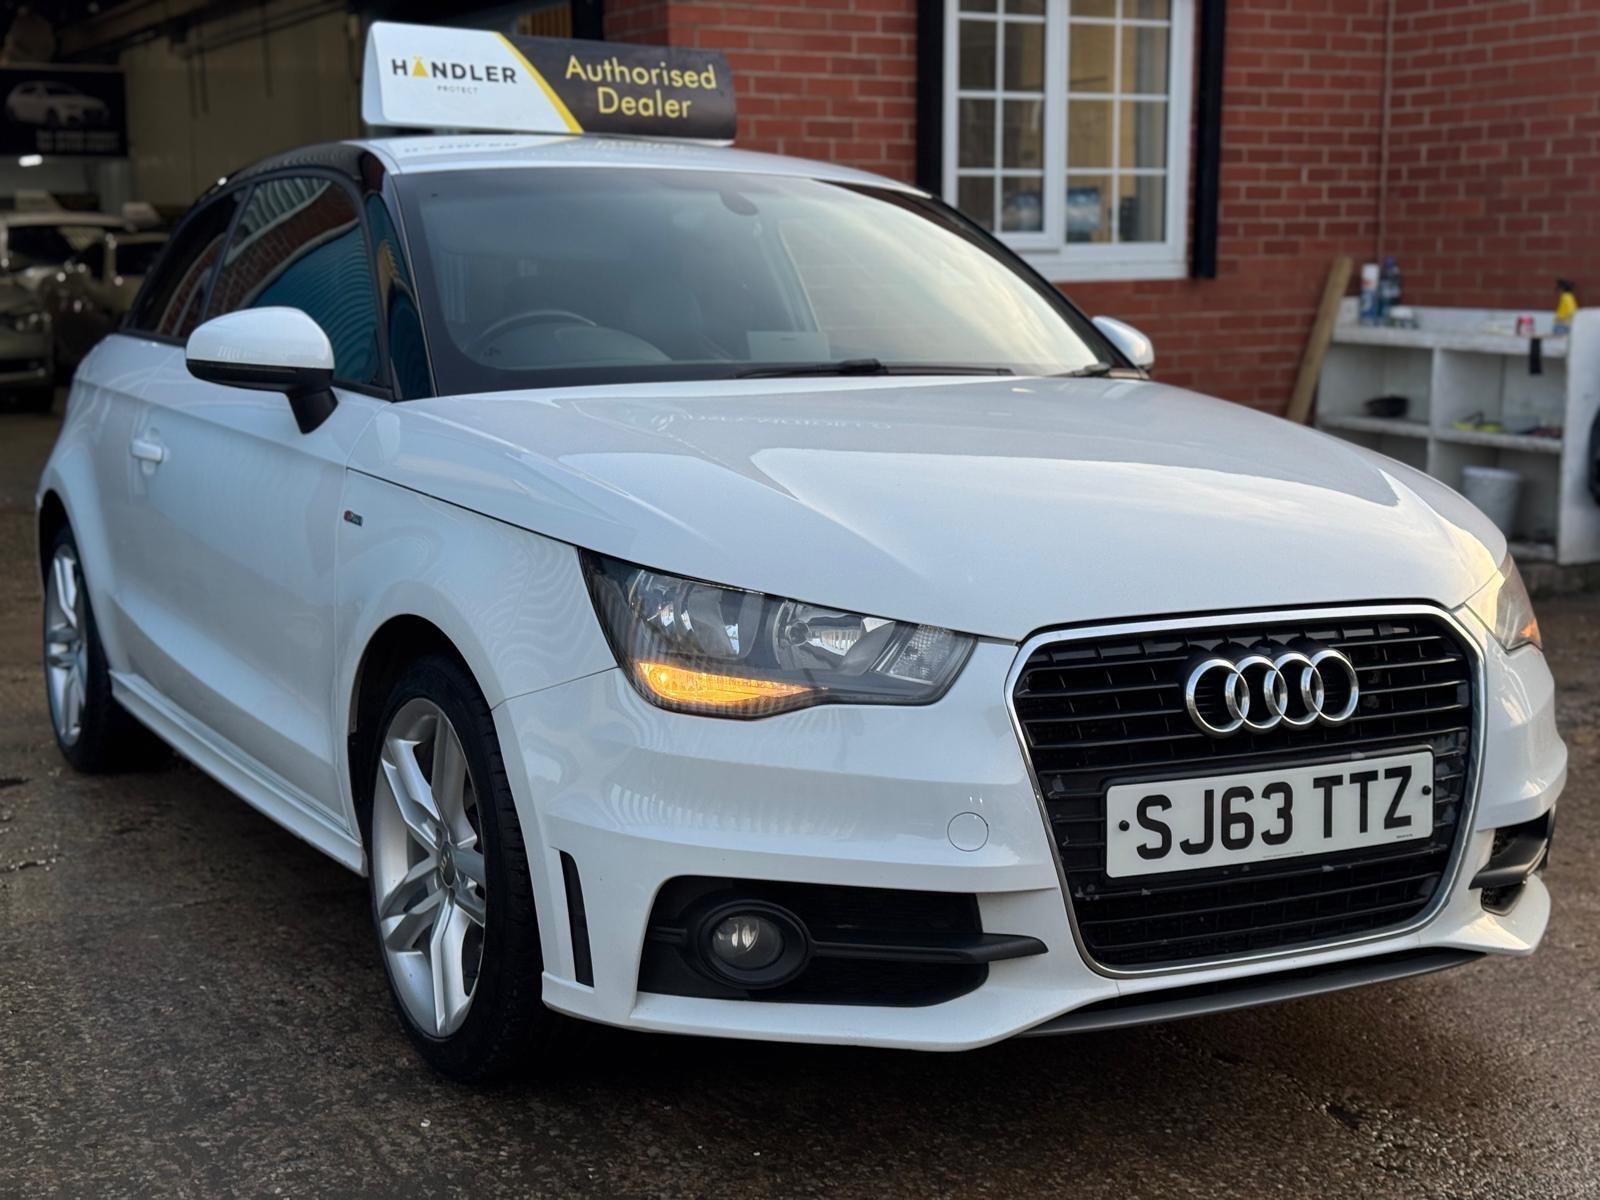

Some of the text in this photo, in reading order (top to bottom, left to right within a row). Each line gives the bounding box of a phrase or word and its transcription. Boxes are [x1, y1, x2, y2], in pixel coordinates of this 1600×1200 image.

[391, 56, 518, 84] HANDLER
[565, 55, 717, 90] Authorised
[436, 84, 479, 95] PROTECT
[597, 87, 692, 118] Dealer
[1136, 765, 1413, 860] SJ63 TTZ
